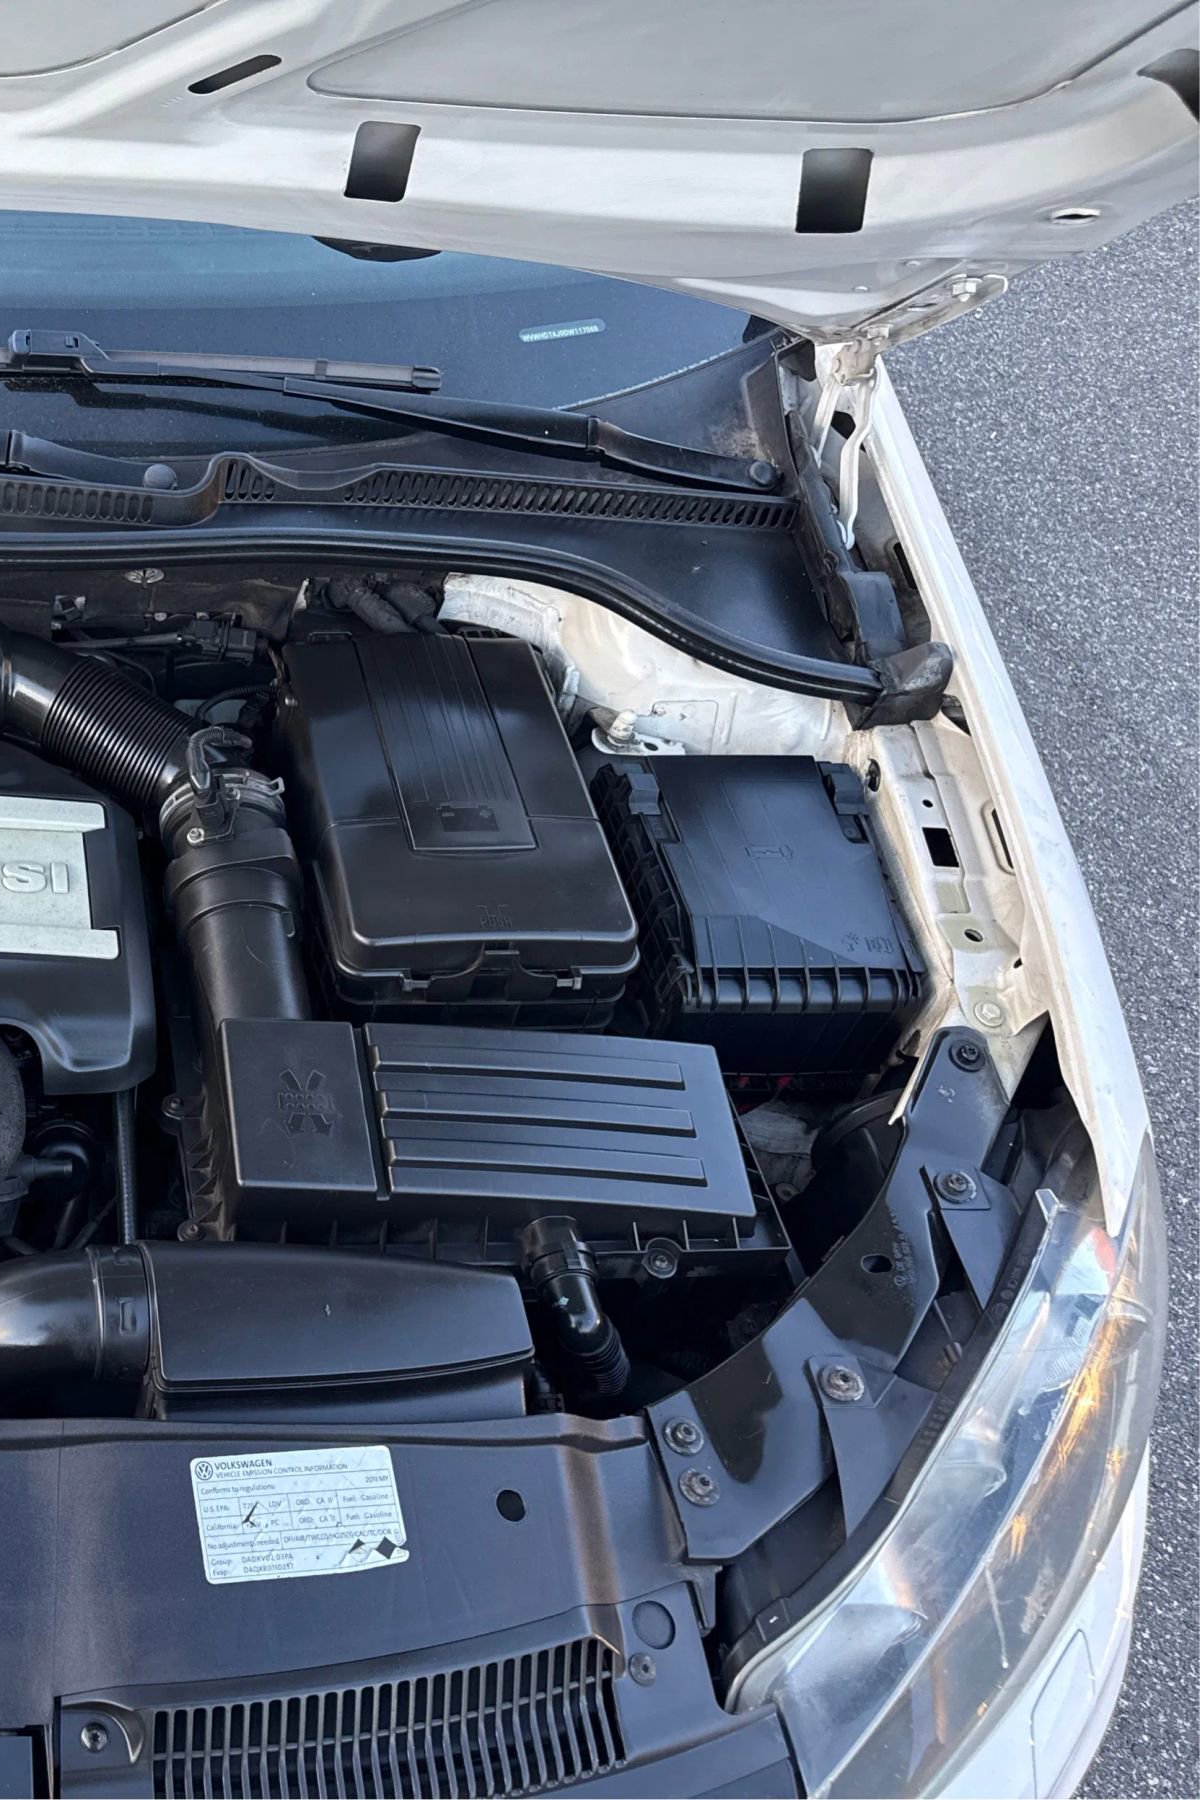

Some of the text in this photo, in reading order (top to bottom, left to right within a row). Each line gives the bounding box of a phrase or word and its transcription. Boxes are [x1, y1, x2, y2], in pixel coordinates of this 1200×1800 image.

[215, 1459, 272, 1470] VOLKSWAGEN
[216, 1464, 347, 1478] VEHICLE EMISSION CONTROL INFORMATION
[360, 1493, 388, 1501] Gasoline
[364, 1511, 392, 1519] Gasoline
